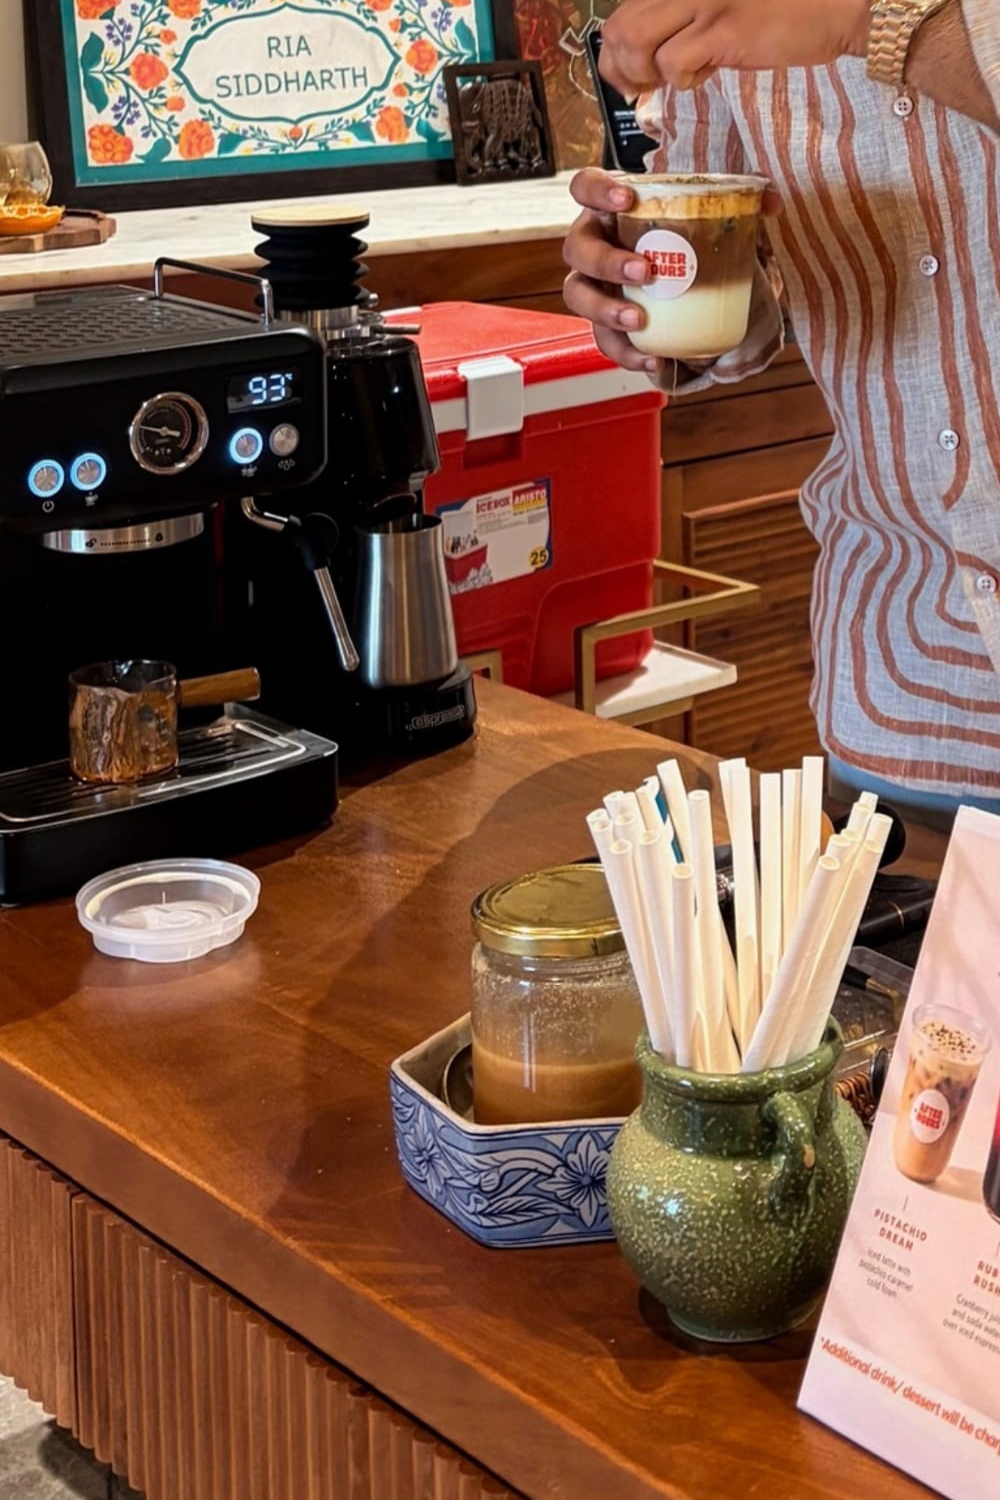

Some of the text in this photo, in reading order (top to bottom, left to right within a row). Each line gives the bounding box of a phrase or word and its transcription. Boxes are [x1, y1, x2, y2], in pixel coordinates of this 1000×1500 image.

[267, 34, 312, 58] RIA
[215, 66, 368, 98] SIDDHARTH
[643, 249, 686, 265] AFTER
[650, 264, 686, 277] OURS
[476, 496, 510, 514] ICEBOX
[530, 549, 547, 566] 25
[874, 1209, 927, 1242] PISTACHIO
[879, 1227, 914, 1251] DREAM
[956, 1294, 989, 1319] Cranberry
[952, 1309, 966, 1320] and
[967, 1315, 983, 1329] soda
[902, 1385, 942, 1416] dessert
[940, 1408, 960, 1427] will
[960, 1416, 974, 1435] be
